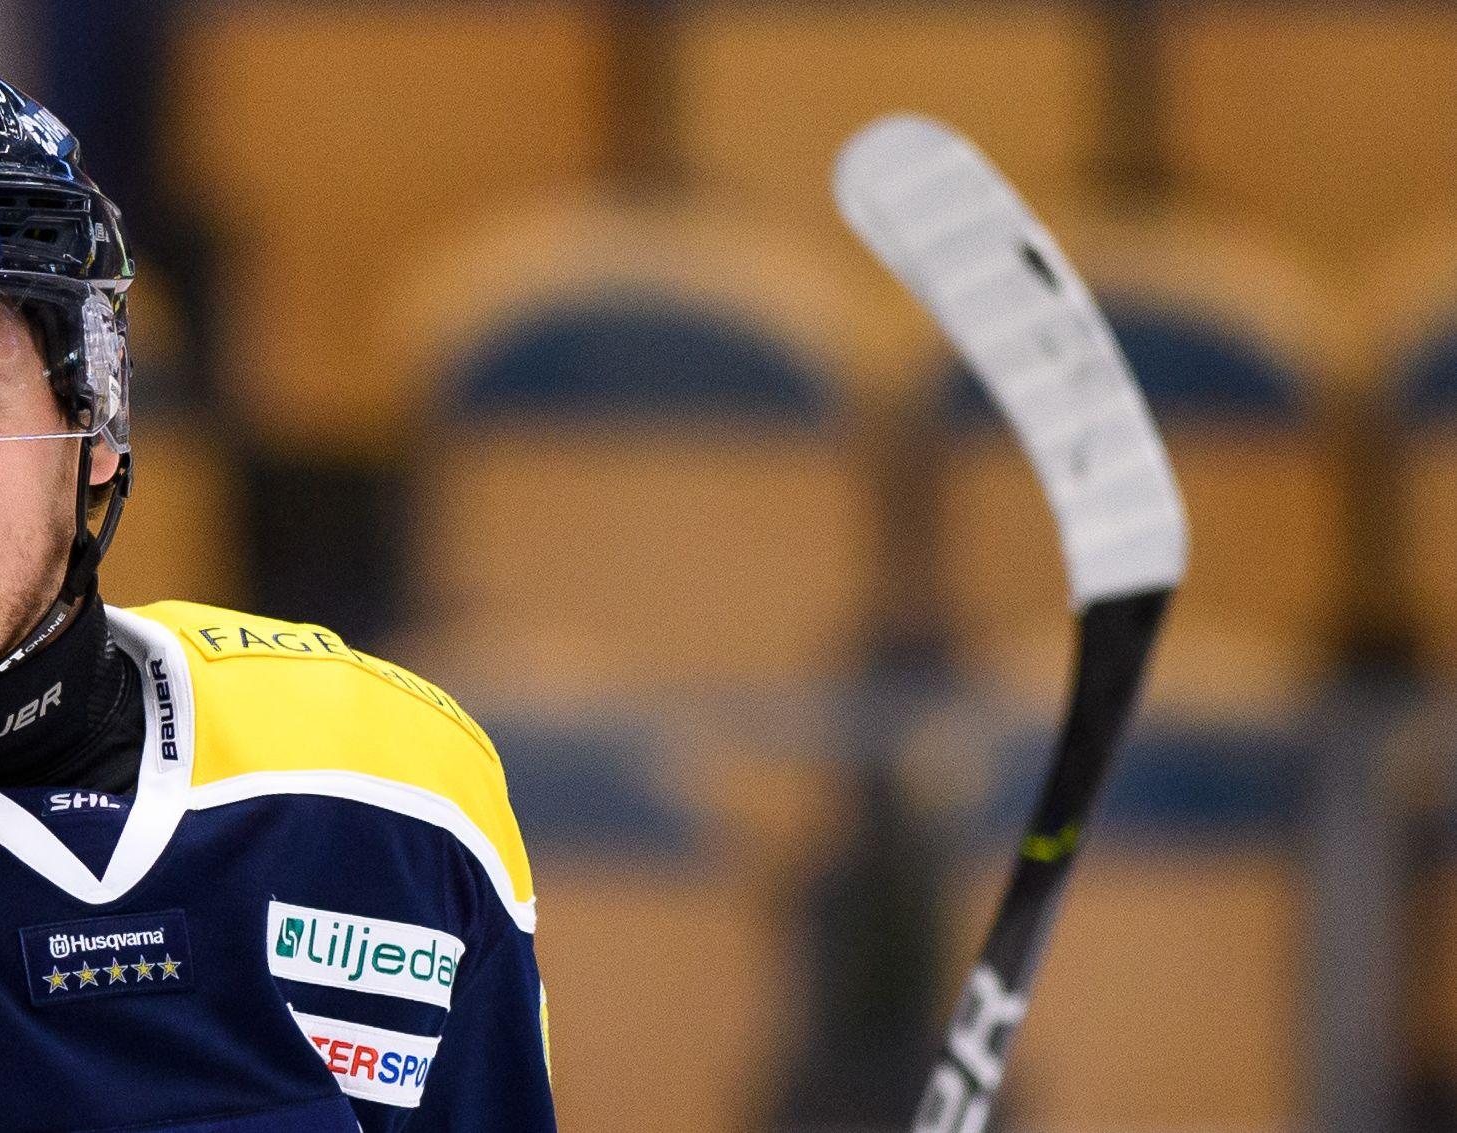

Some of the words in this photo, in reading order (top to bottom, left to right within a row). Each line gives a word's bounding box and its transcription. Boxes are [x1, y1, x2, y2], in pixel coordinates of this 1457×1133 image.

[50, 793, 121, 812] SHL
[70, 929, 165, 953] Husqvarna
[307, 918, 458, 987] Liljeda
